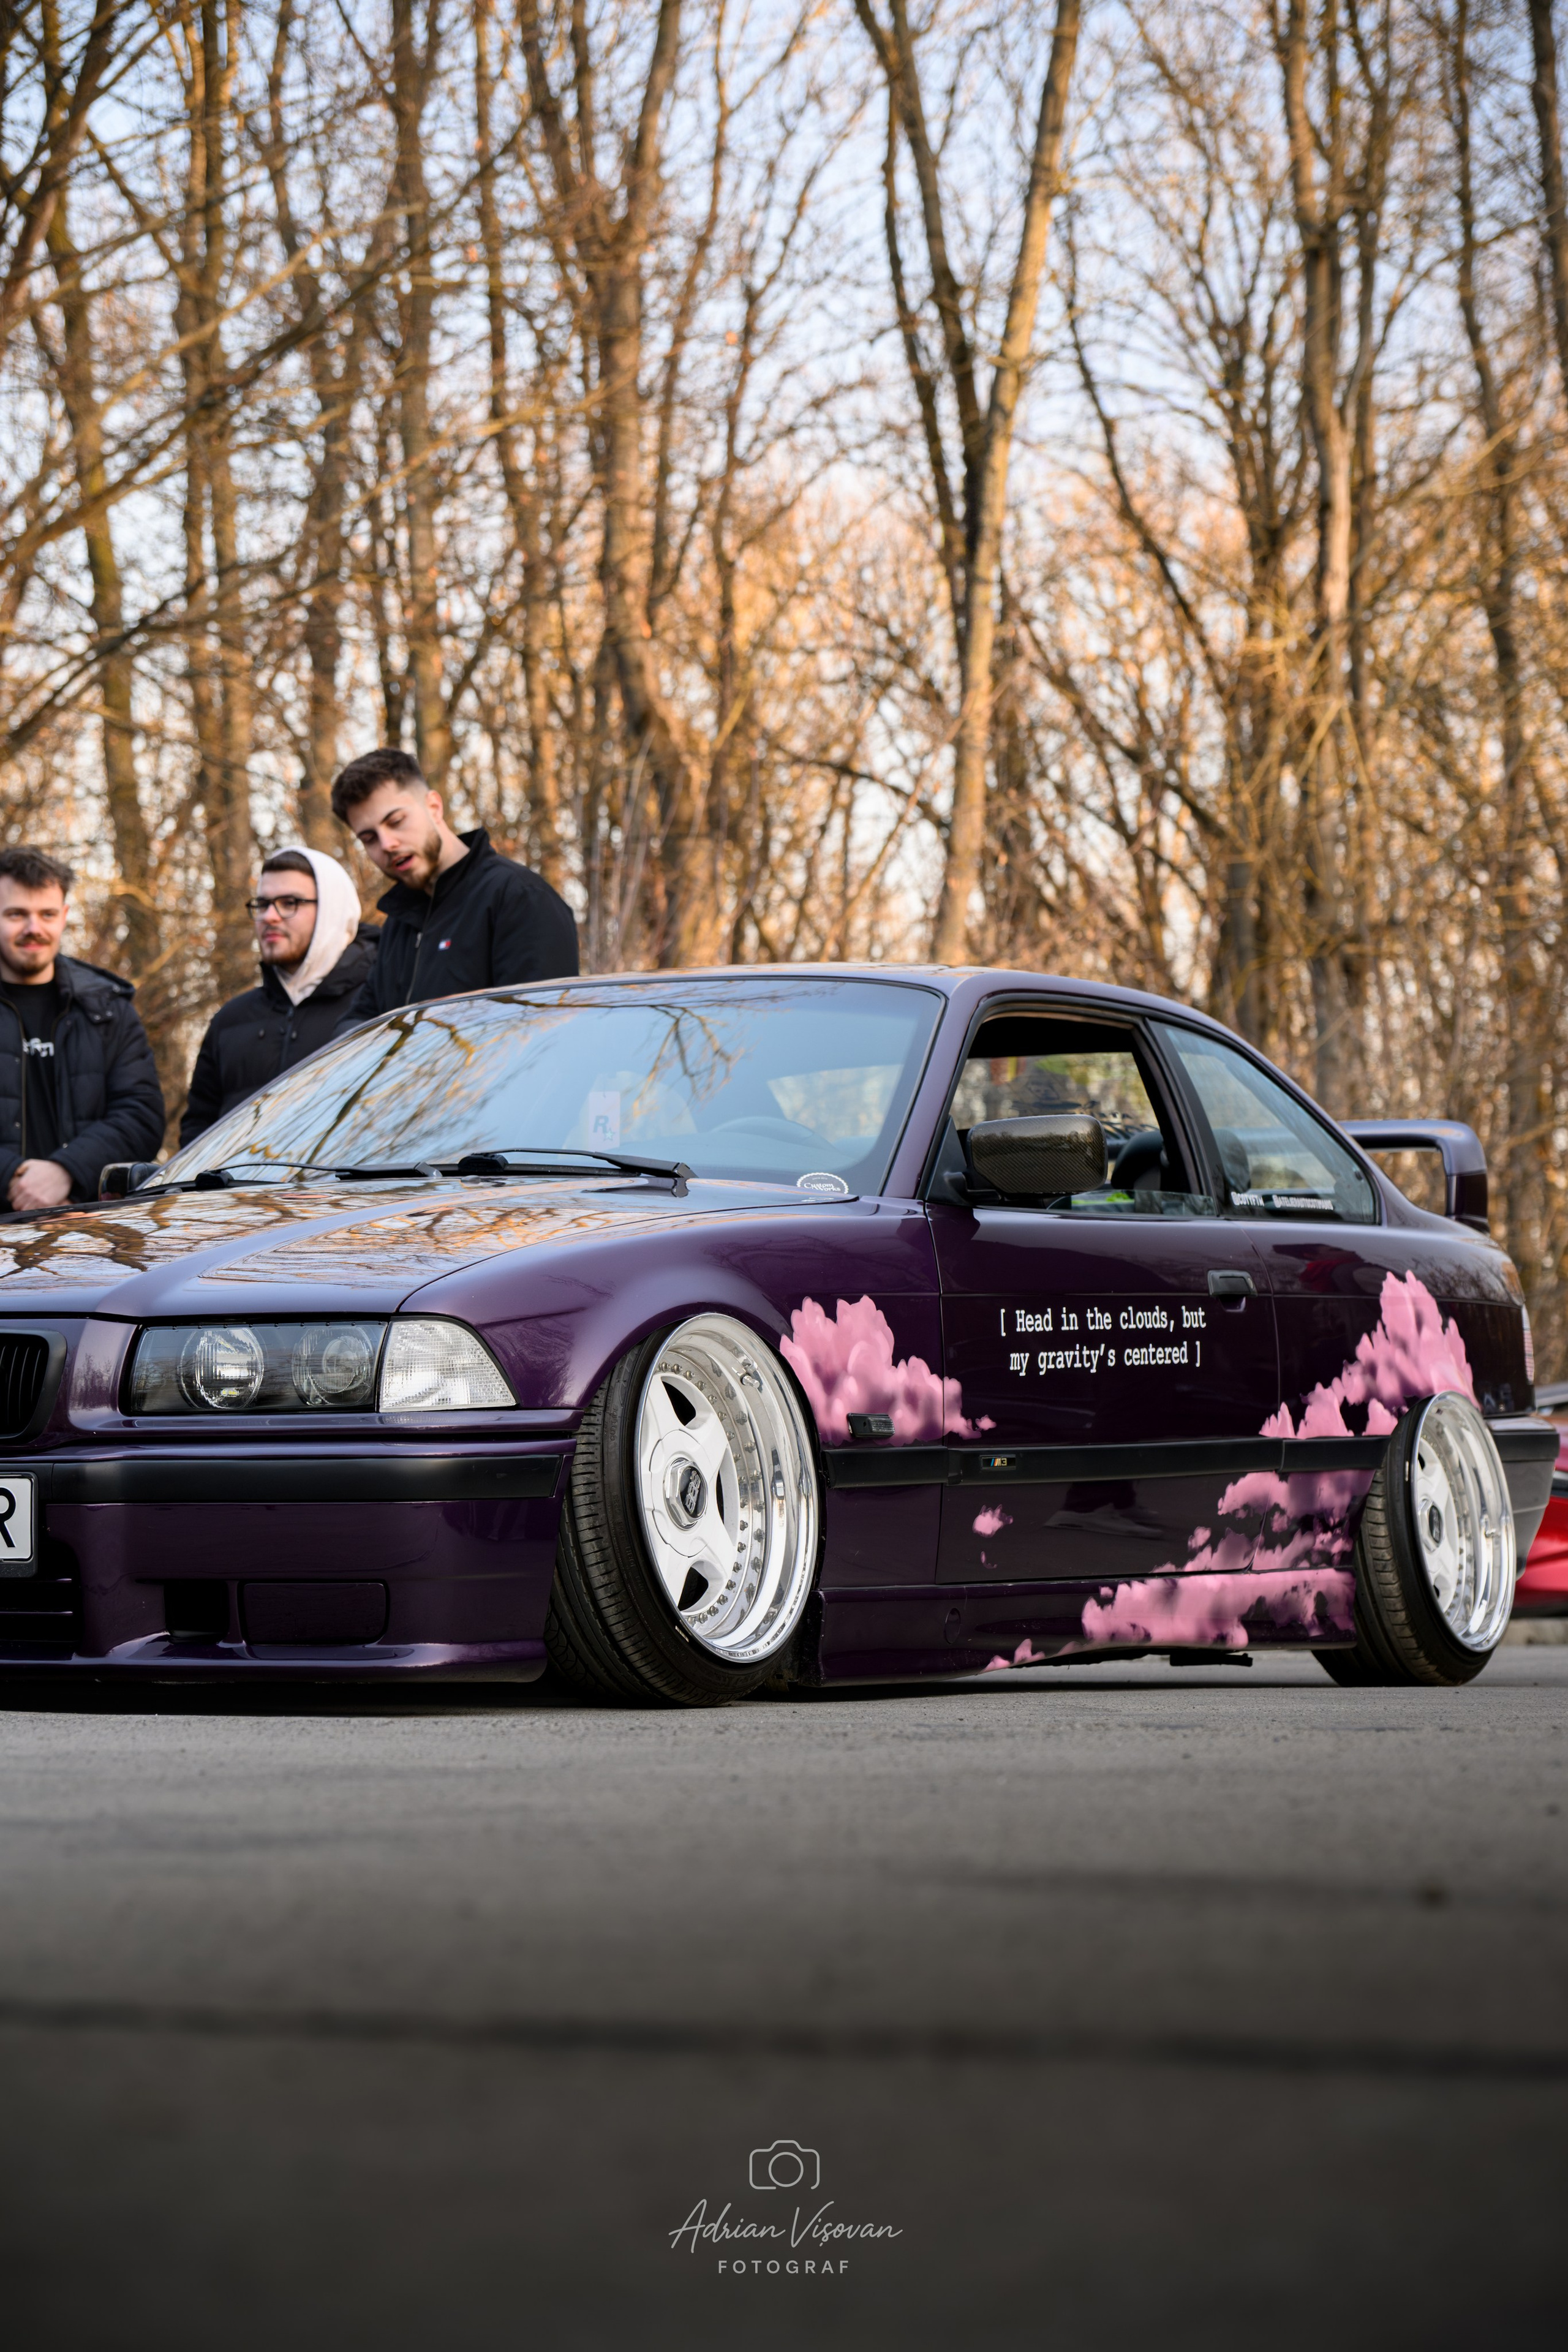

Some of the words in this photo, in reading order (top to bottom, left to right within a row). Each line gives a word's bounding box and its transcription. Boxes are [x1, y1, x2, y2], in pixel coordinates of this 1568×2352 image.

[1016, 1308, 1053, 1332] Head
[1061, 1306, 1079, 1331] in
[1086, 1306, 1112, 1330] the
[1120, 1305, 1174, 1333] clouds,
[1182, 1305, 1207, 1329] but
[1009, 1352, 1030, 1376] my
[1038, 1343, 1116, 1376] gravity's
[1123, 1341, 1189, 1366] centered
